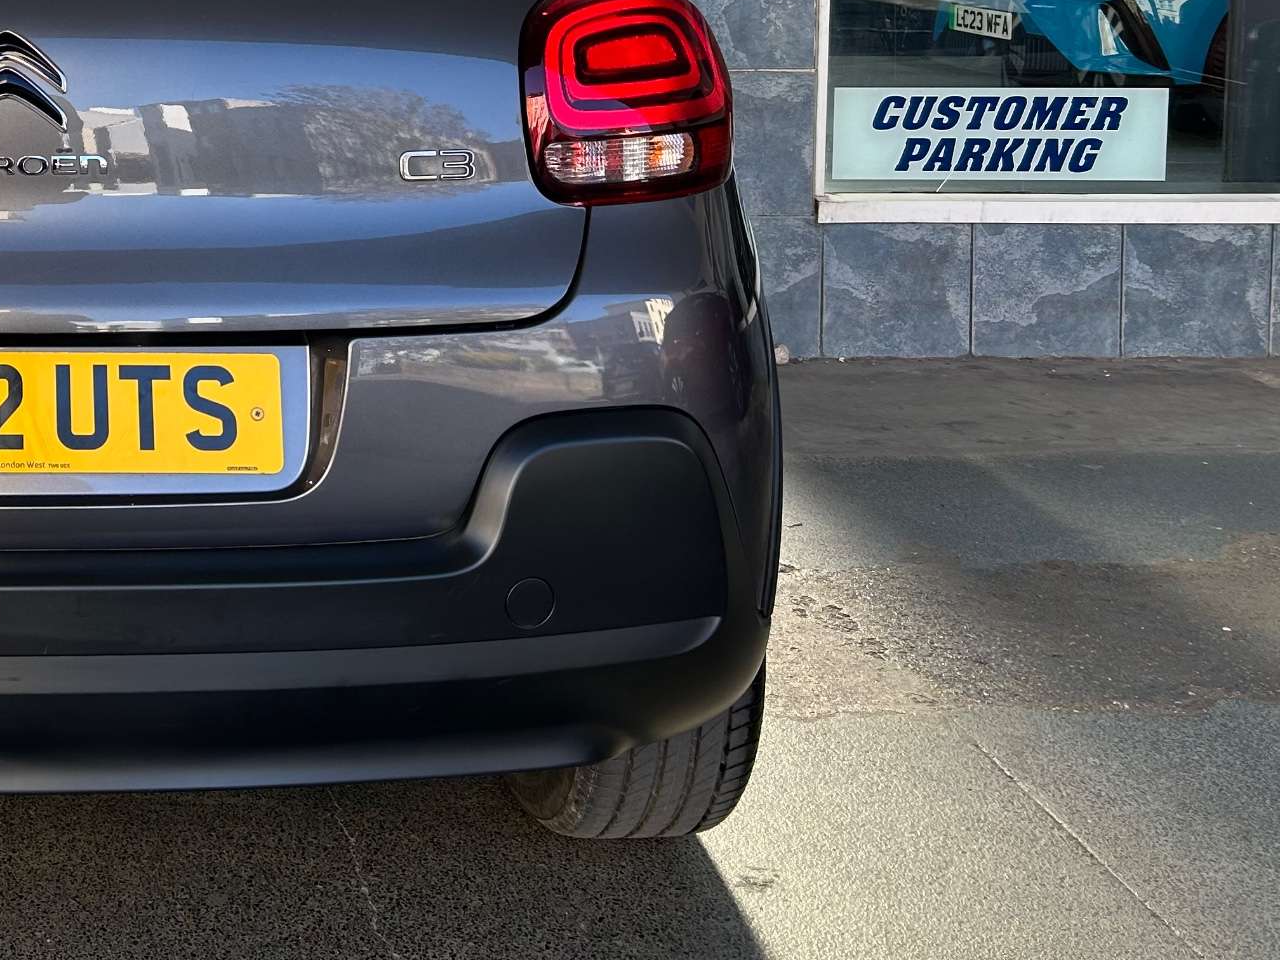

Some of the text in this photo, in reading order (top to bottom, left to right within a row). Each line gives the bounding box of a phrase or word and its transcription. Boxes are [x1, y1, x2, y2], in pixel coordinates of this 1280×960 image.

[956, 7, 984, 31] LC23
[871, 95, 1129, 131] CUSTOMER
[399, 149, 476, 180] C3
[894, 137, 1104, 173] PARKING
[55, 363, 238, 451] UTS
[26, 460, 46, 469] West
